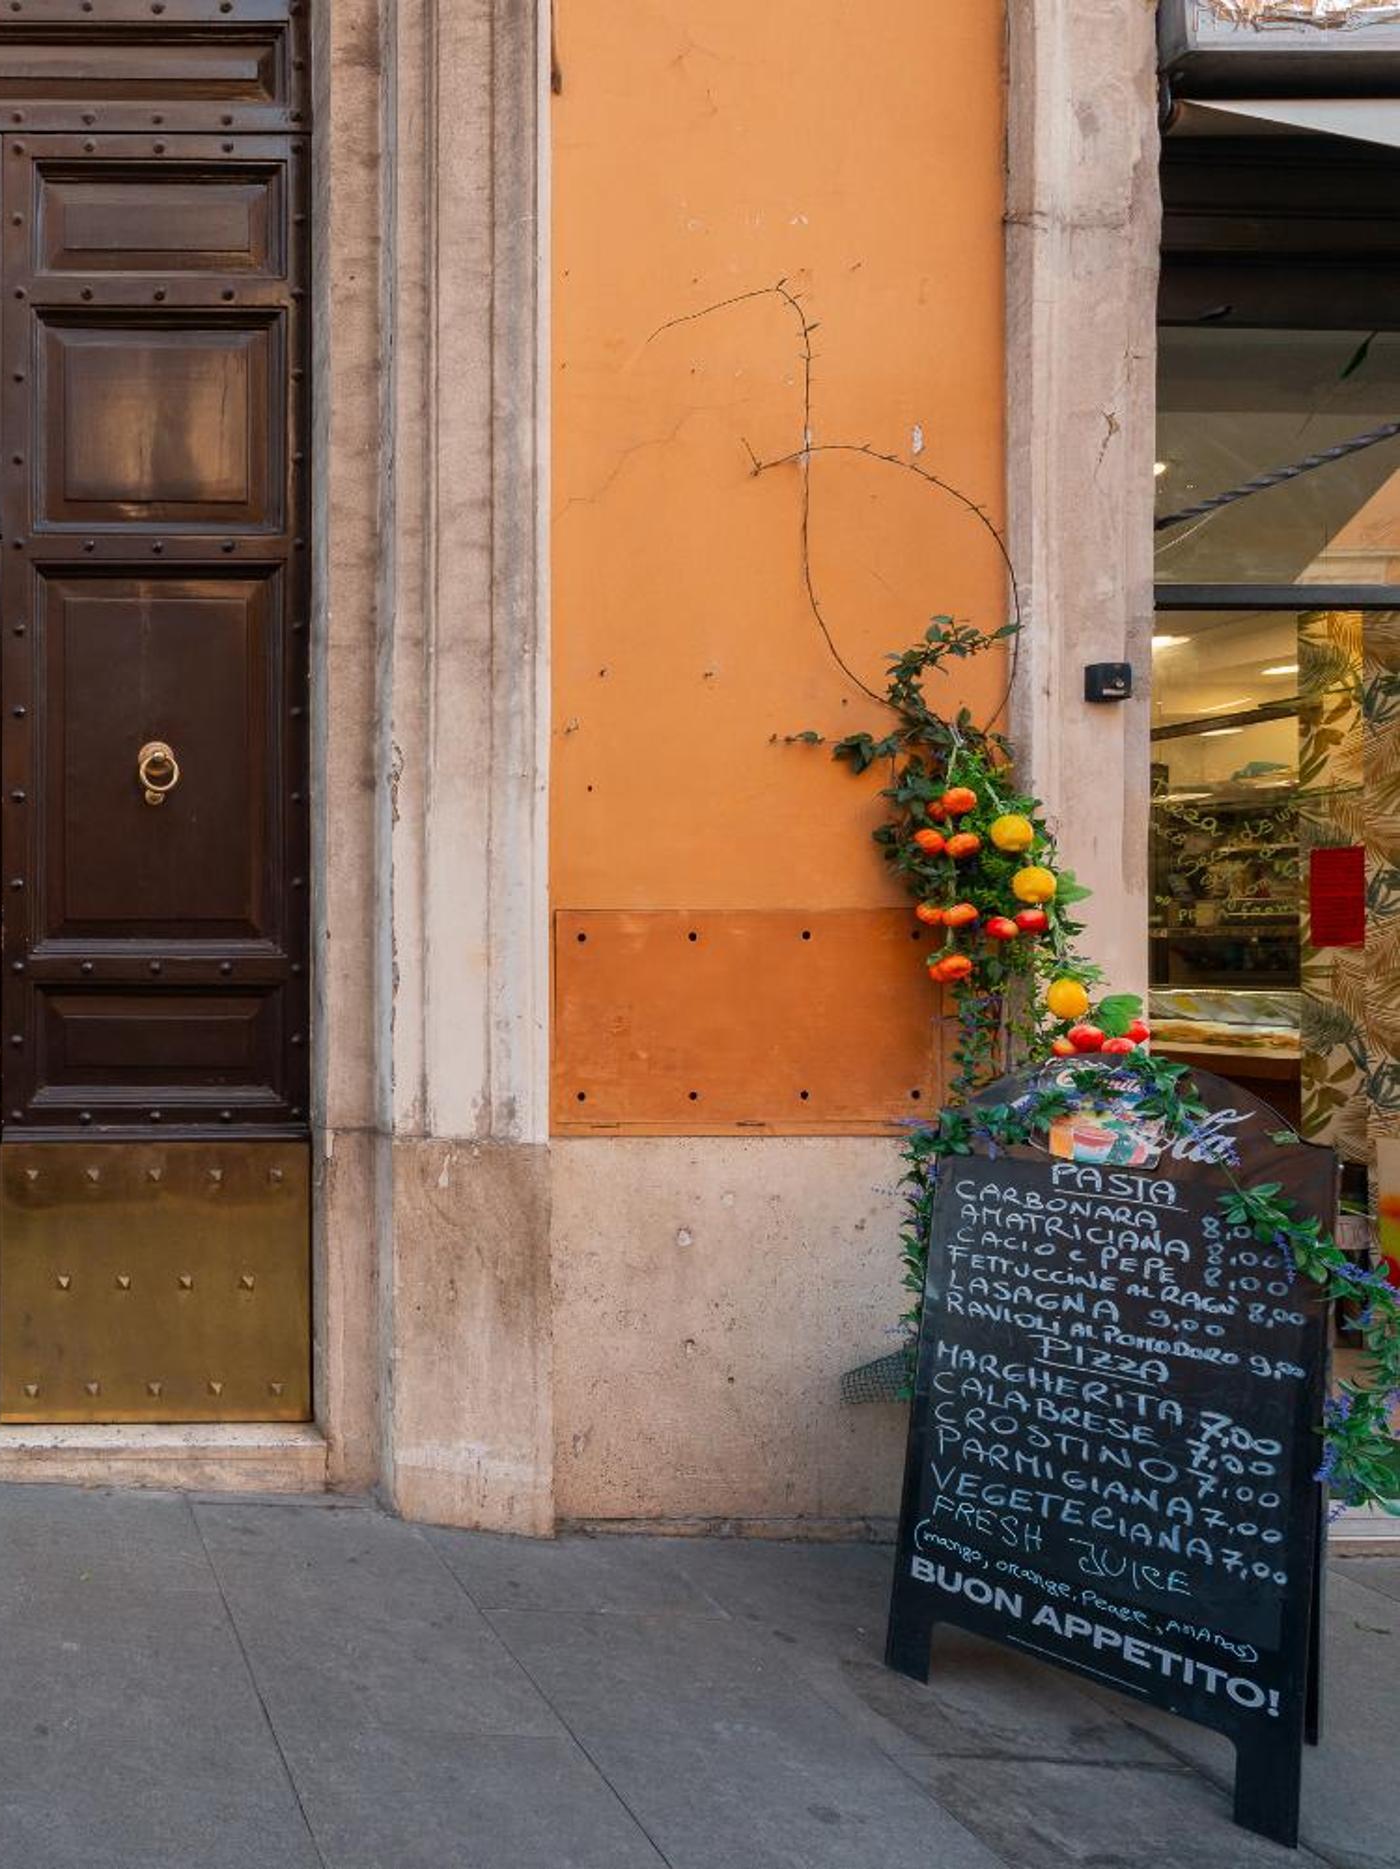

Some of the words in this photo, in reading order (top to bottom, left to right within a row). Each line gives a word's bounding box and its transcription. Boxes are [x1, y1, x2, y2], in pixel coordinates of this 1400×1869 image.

[956, 1181, 1157, 1230] CARBONARA
[1052, 1163, 1176, 1204] PASTA
[957, 1228, 1055, 1256] CACIO
[1100, 1247, 1176, 1284] PEPE
[950, 1271, 1119, 1323] LASAGNA
[1127, 1283, 1156, 1299] AL
[1071, 1322, 1098, 1340] AL
[1029, 1335, 1169, 1383] PIZZA
[934, 1372, 1160, 1447] CALABRESE
[935, 1426, 1194, 1526] PARMIGIANA
[932, 1496, 1043, 1552] FRESH
[1068, 1537, 1196, 1597] JUICE
[910, 1555, 1022, 1619] BUON
[1032, 1606, 1279, 1717] APPETITO!
